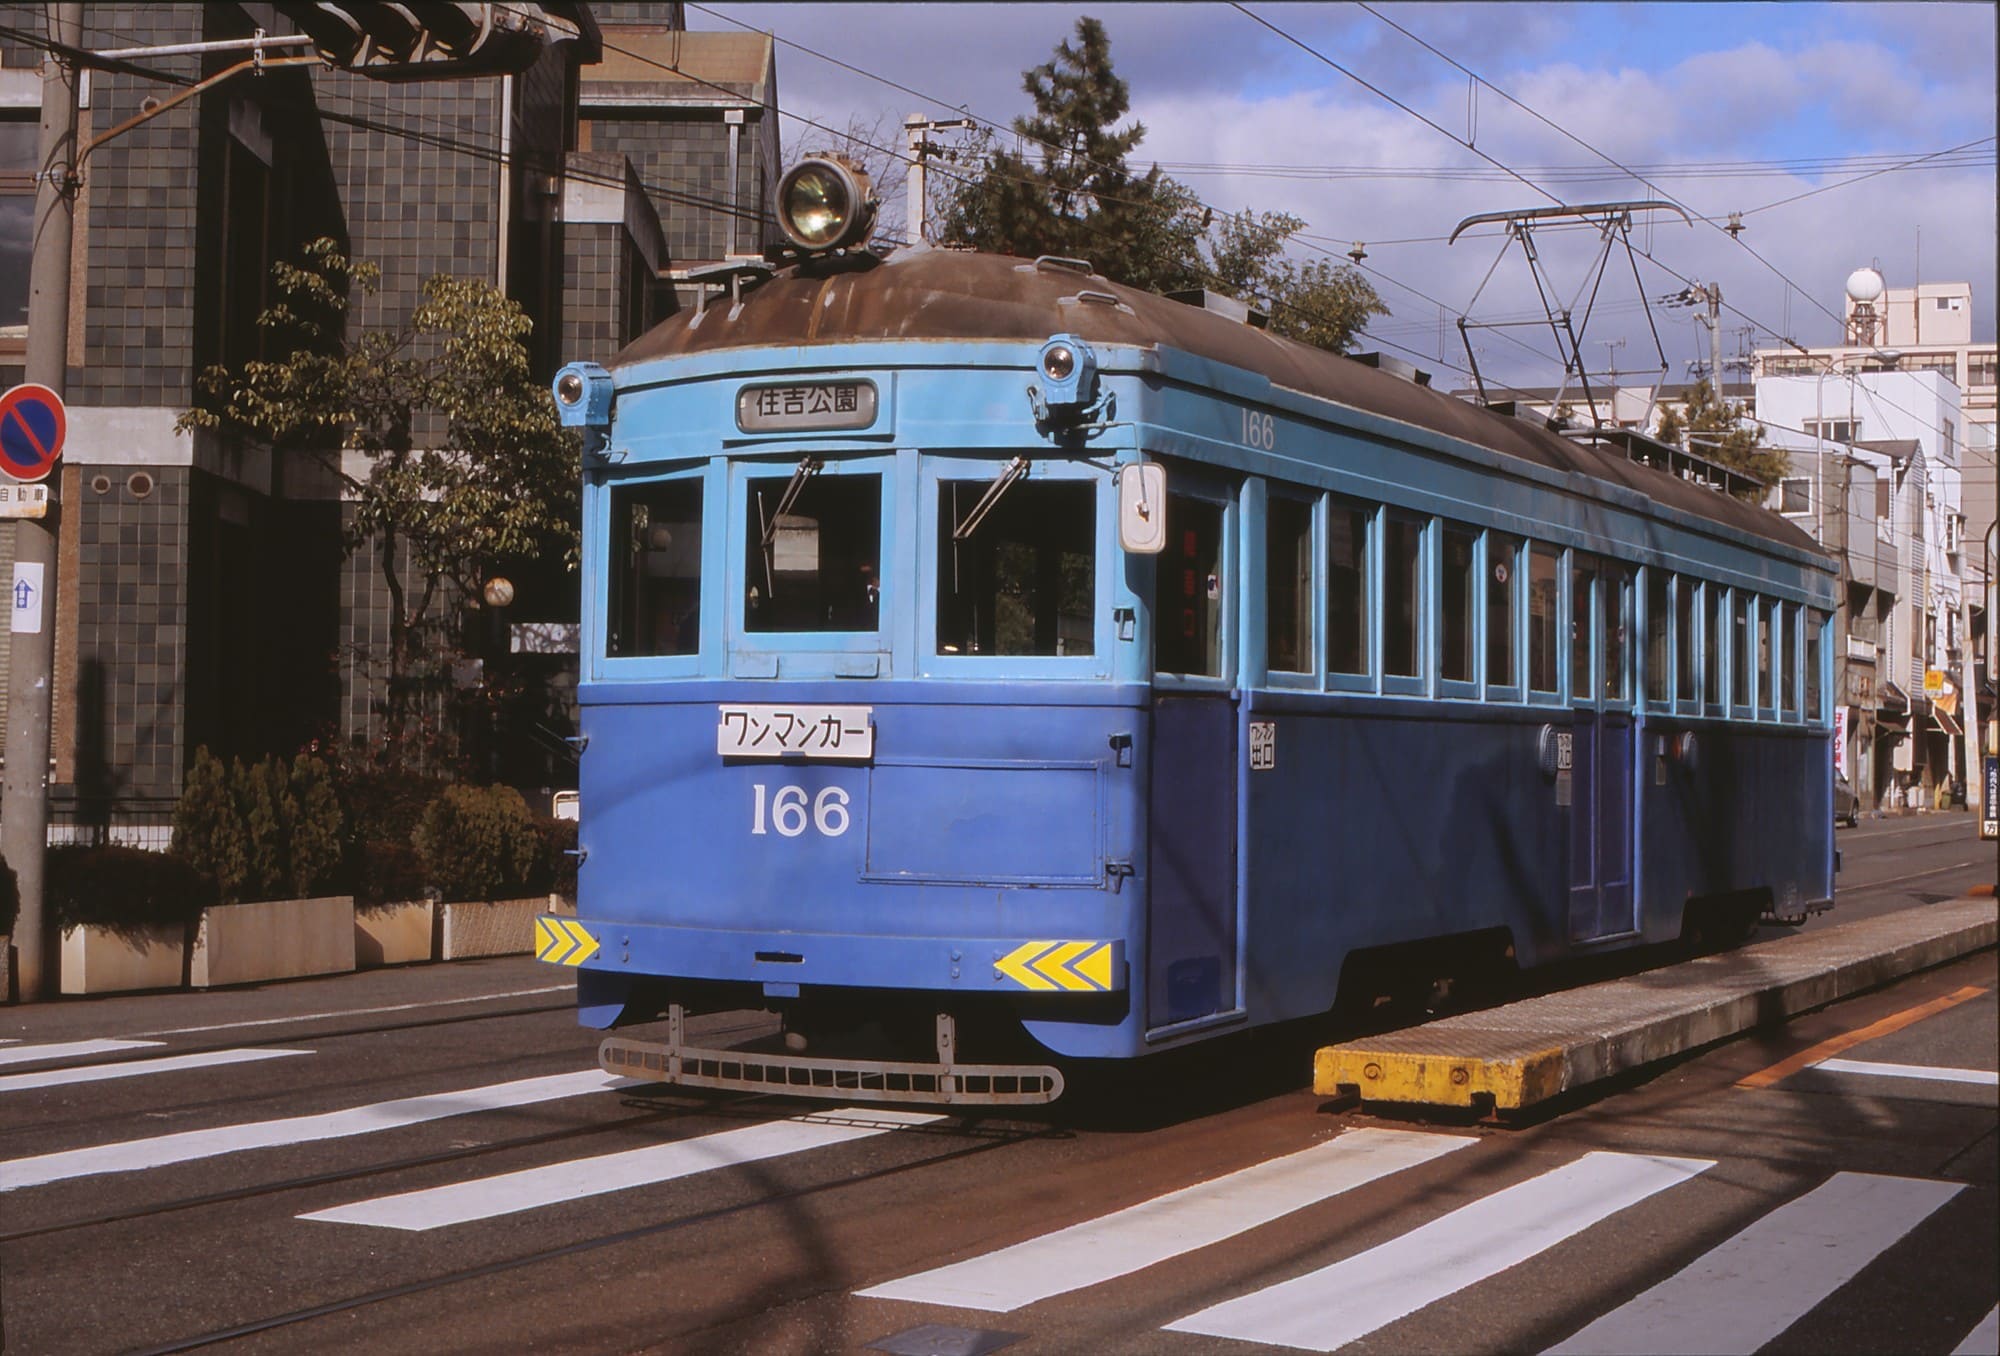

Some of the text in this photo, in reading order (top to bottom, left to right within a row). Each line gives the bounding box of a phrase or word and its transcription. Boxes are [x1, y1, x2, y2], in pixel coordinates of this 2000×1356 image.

[756, 385, 858, 417] 住吉公園
[1241, 407, 1275, 450] 166
[724, 712, 865, 748] ワンマンカー
[1252, 743, 1273, 766] 出口
[751, 784, 850, 837] 166
